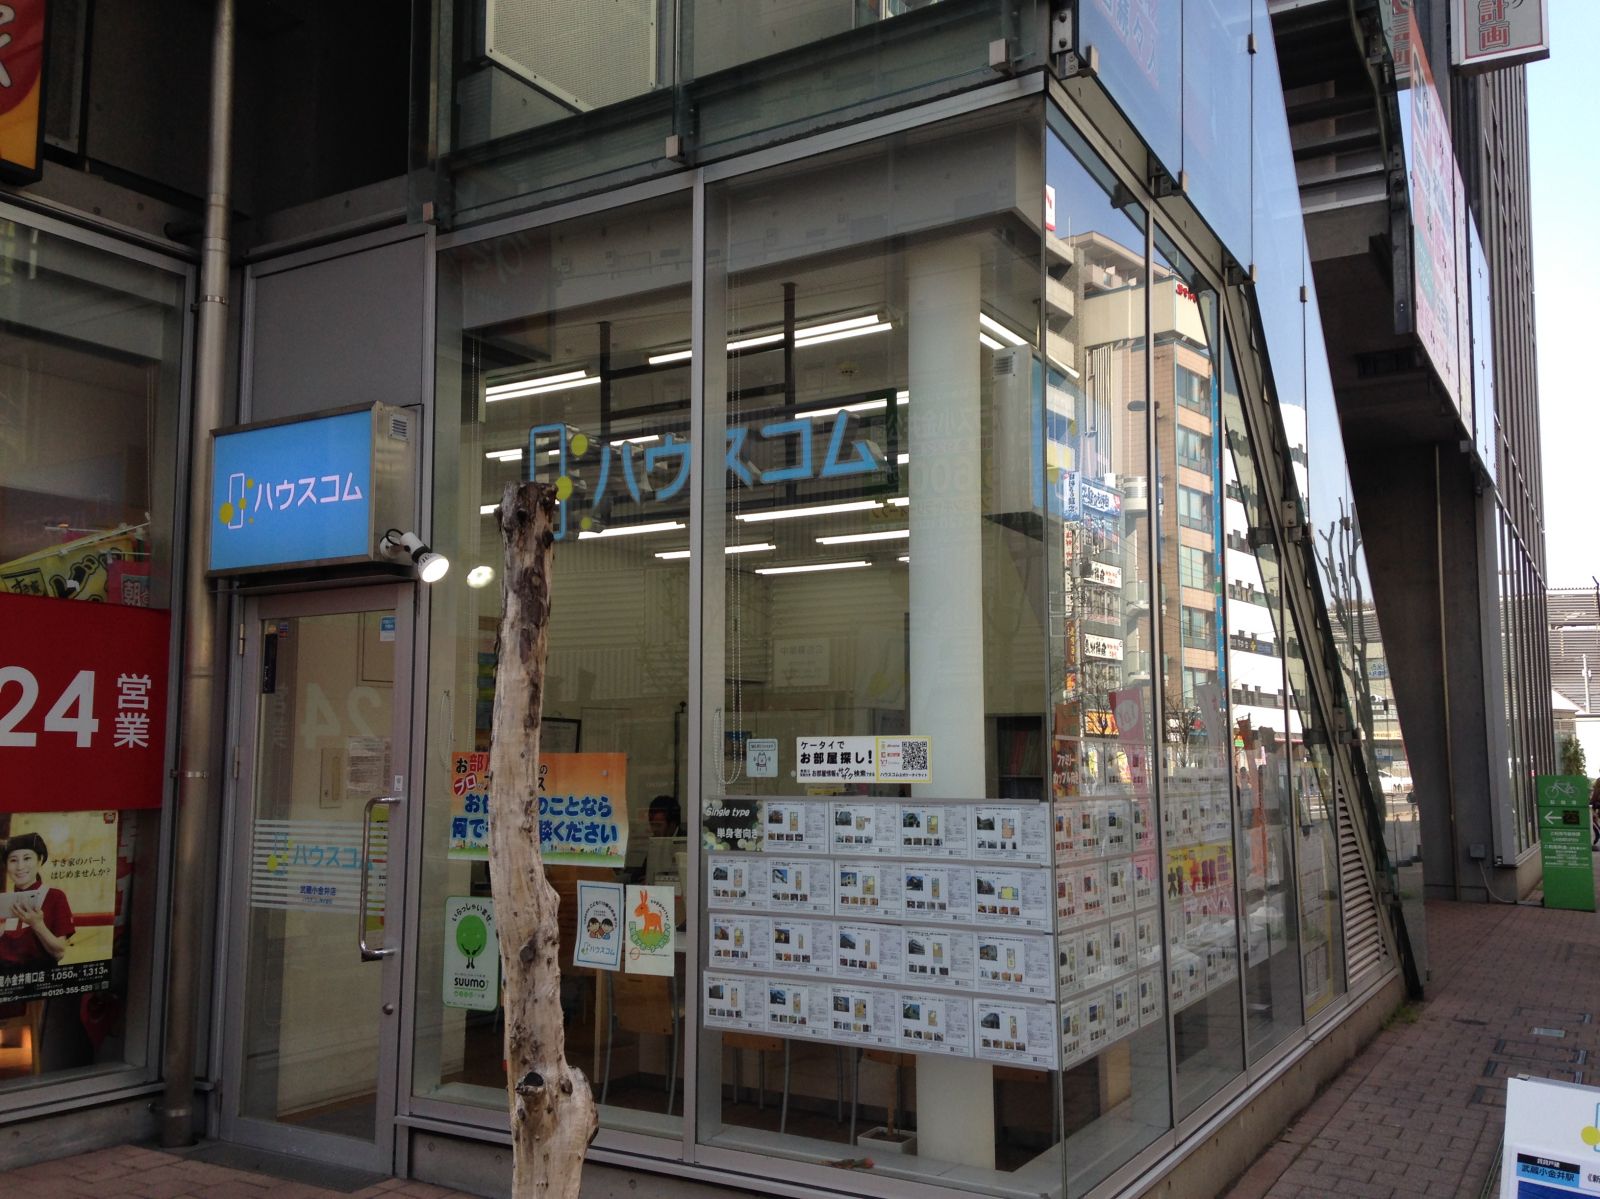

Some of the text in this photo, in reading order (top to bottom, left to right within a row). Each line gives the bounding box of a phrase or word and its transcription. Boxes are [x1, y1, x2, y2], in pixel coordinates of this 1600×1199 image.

[592, 409, 879, 507] ハウスコム
[254, 472, 363, 513] ハウスコム
[0, 666, 99, 748] 24
[113, 673, 151, 748] 営業
[800, 741, 845, 750] ケータイで
[800, 750, 873, 765] お部屋探し!
[705, 807, 750, 818] Single type
[717, 828, 758, 840] 単身者向き
[51, 856, 106, 868] すき家のパート
[51, 868, 111, 880] はじめませんか?
[1521, 1165, 1575, 1182] 武蔵小金井駅
